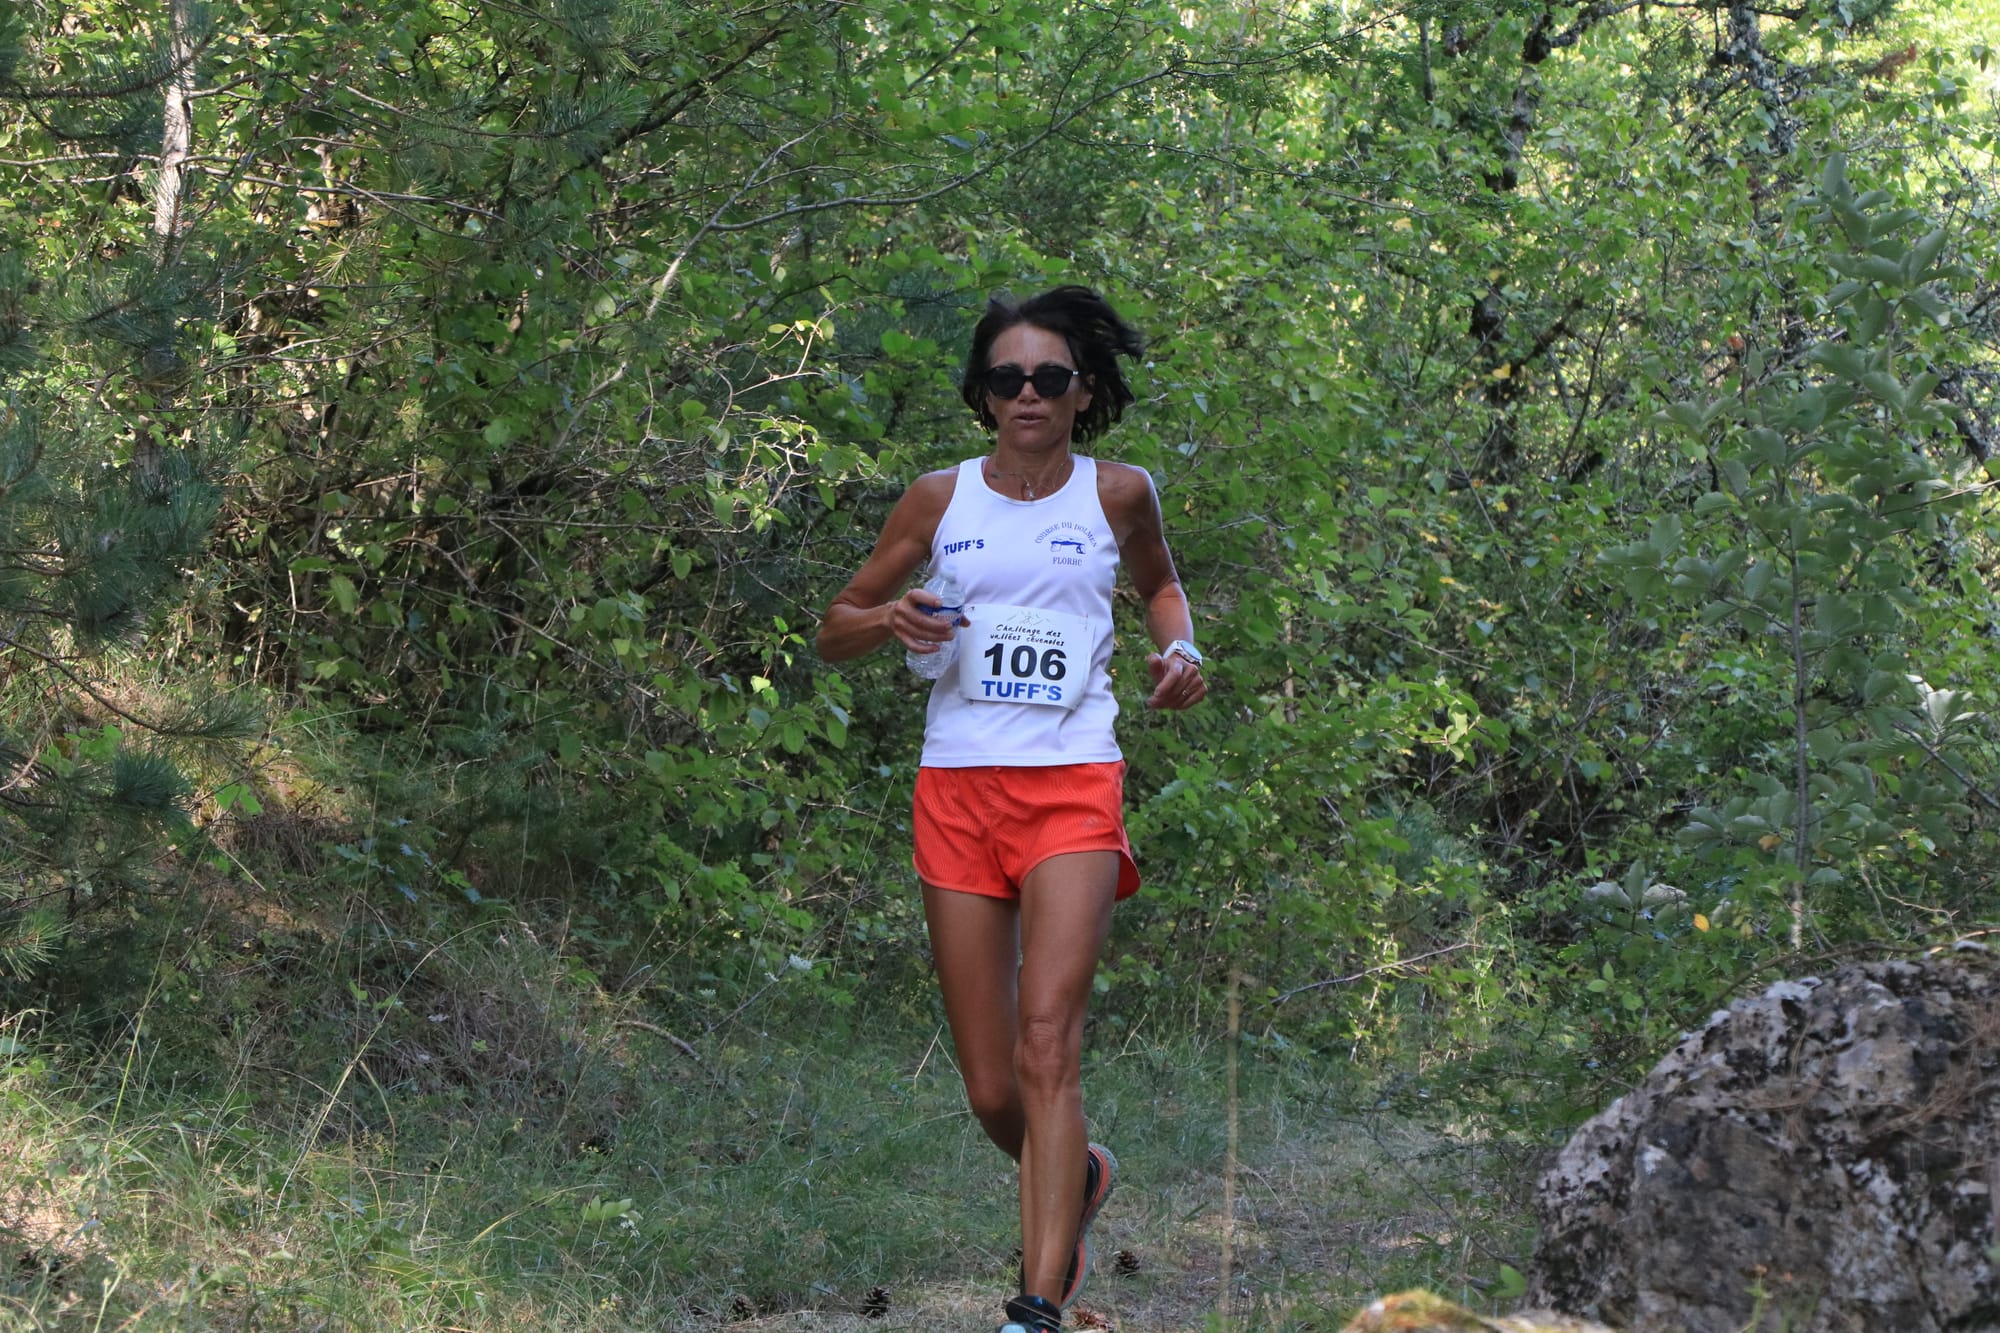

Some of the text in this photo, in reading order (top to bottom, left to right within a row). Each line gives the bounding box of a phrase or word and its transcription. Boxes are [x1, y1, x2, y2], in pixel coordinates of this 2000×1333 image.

[1061, 521, 1072, 529] DU
[943, 539, 985, 556] TUFF'S
[995, 624, 1061, 638] Challenge des
[990, 633, 1065, 647] vallées cévenoles
[984, 643, 1067, 681] 106
[981, 680, 1062, 701] TUFF'S
